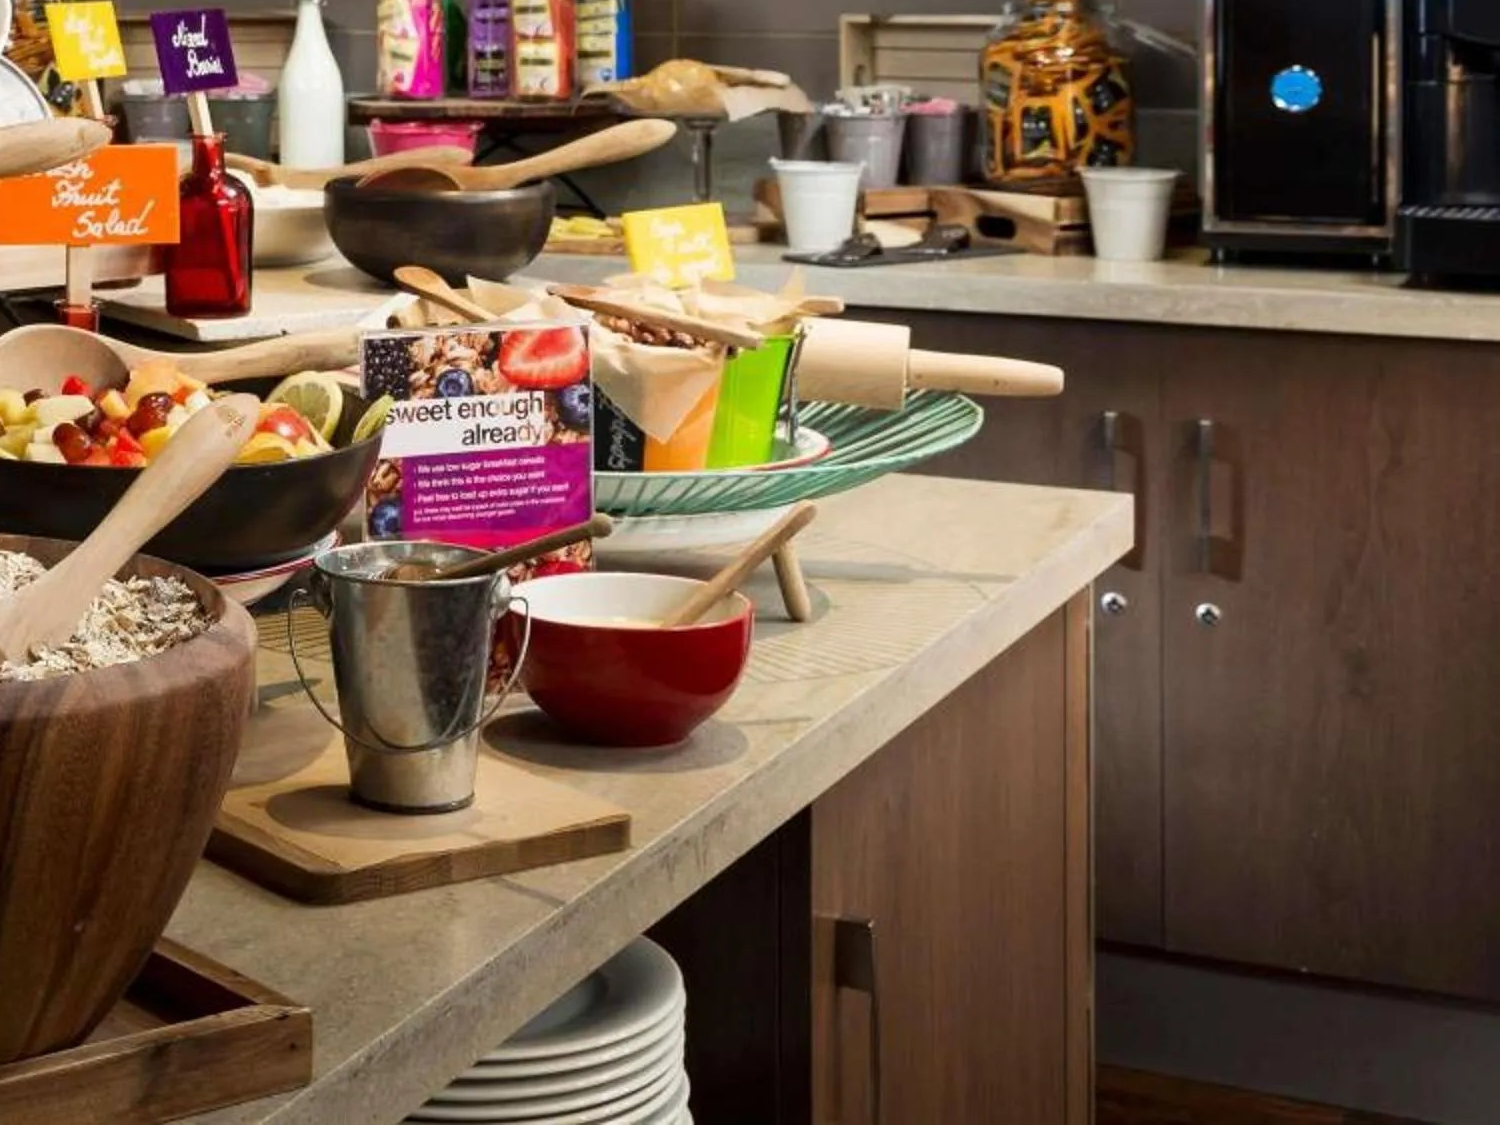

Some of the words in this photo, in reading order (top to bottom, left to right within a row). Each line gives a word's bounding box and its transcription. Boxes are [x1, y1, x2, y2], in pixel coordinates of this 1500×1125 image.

[51, 178, 122, 208] Fruit
[71, 199, 155, 238] Salad
[385, 400, 453, 425] sweet
[457, 391, 543, 420] enough
[461, 424, 542, 445] already
